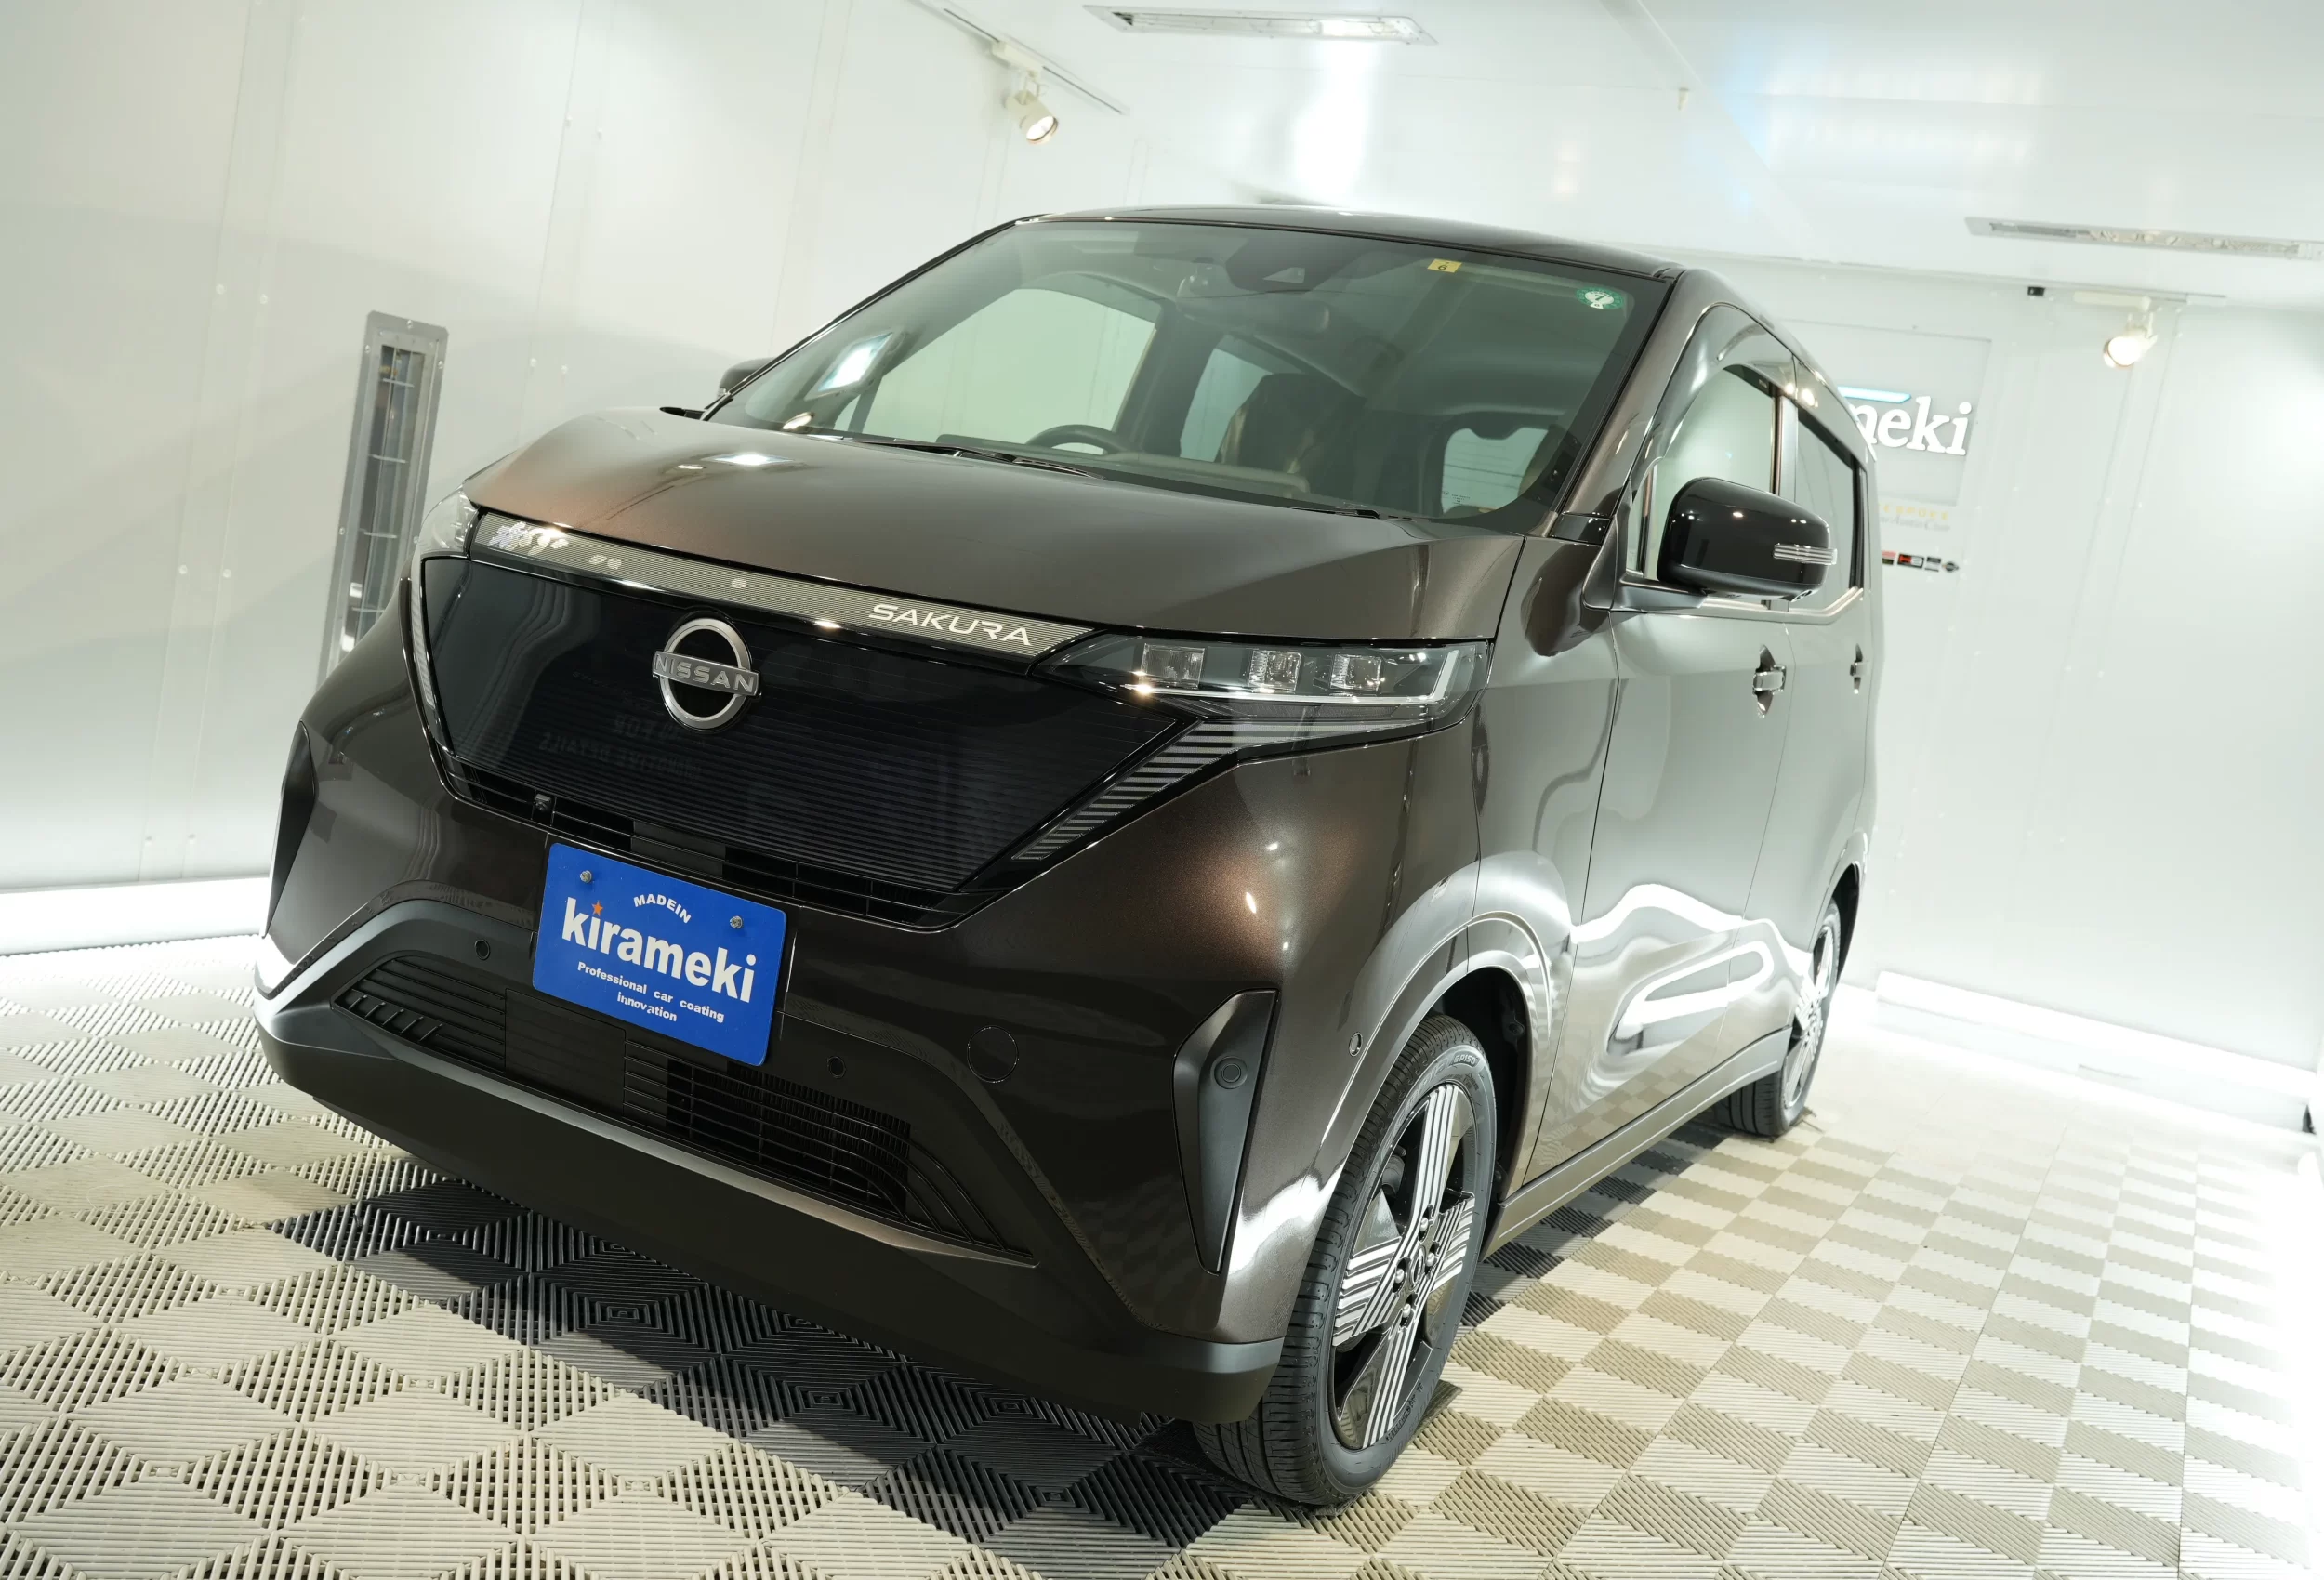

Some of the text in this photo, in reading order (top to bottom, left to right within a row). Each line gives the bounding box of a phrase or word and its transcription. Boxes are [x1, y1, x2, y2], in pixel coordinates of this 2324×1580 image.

[868, 603, 1033, 647] SAKURA
[654, 653, 756, 693] NISSAN
[633, 894, 692, 924] MADEIN
[561, 897, 757, 1003] kirameki
[577, 961, 725, 1023] Professional car coating
[617, 991, 678, 1022] innovation
